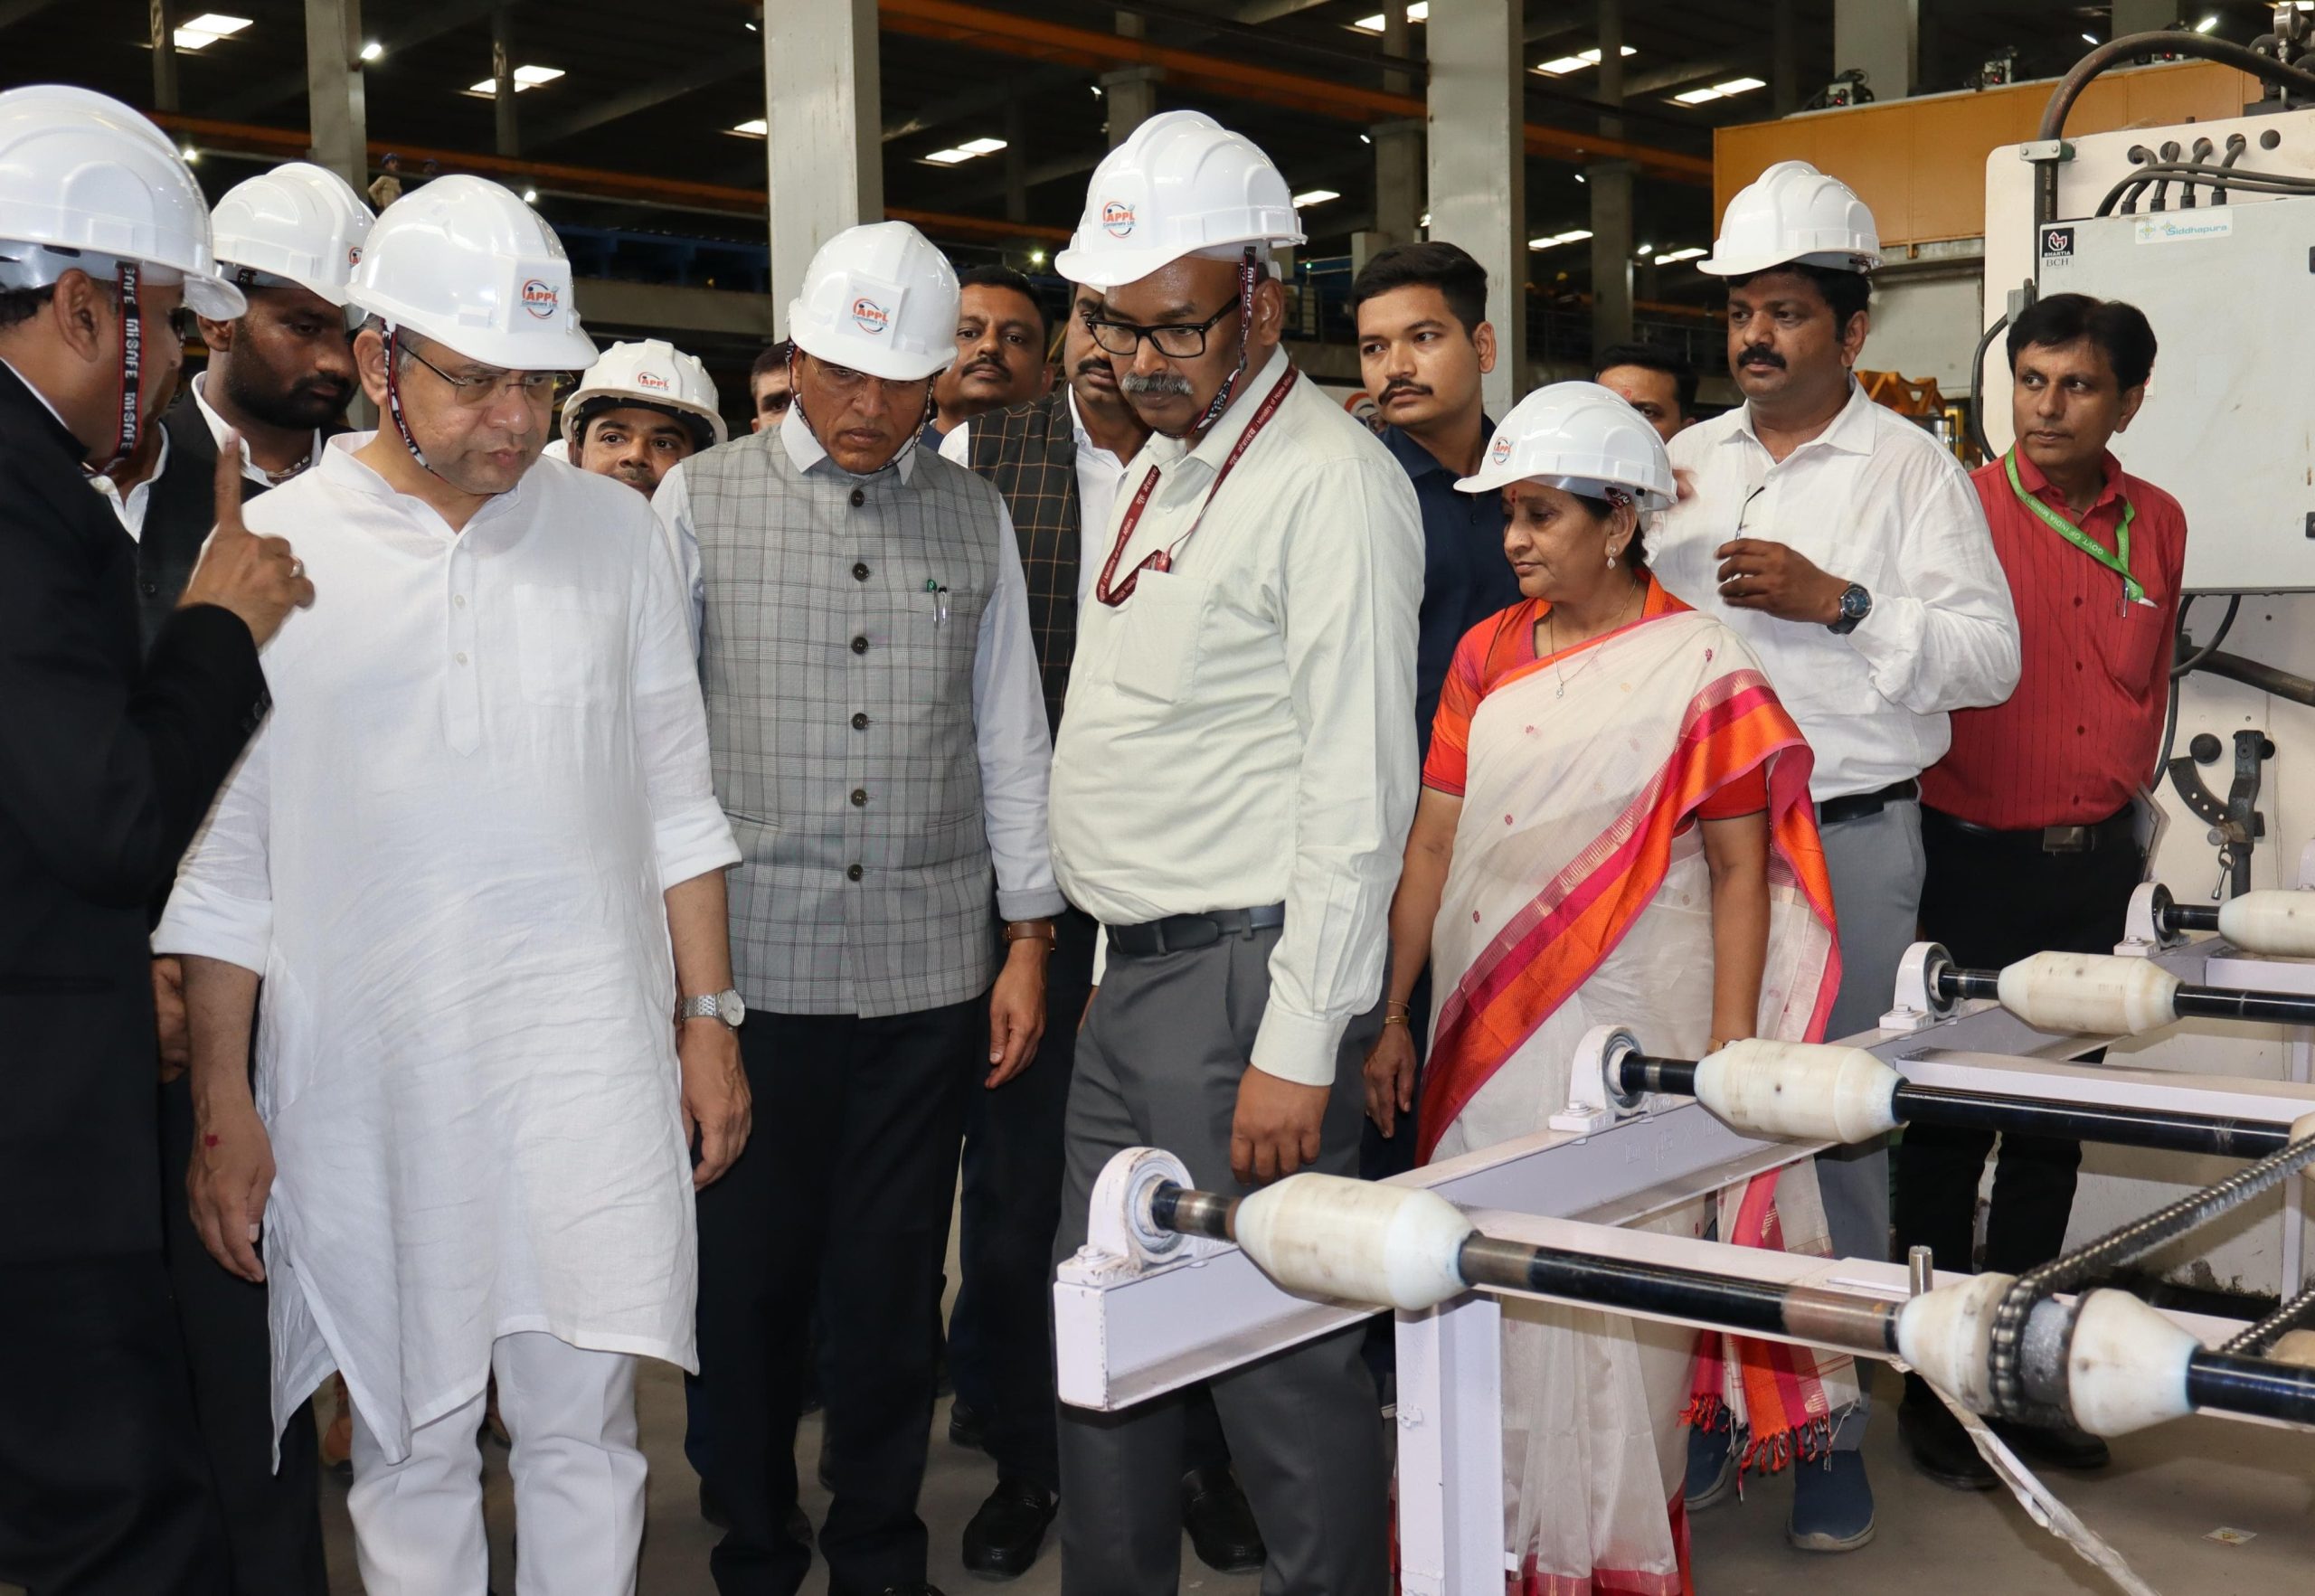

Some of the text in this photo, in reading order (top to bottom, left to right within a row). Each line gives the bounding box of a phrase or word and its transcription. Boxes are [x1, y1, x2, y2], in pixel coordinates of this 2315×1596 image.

[1106, 212, 1135, 222] APPL
[2166, 223, 2227, 236] Siddhapura
[2046, 258, 2069, 267] BCH
[526, 291, 558, 304] APPL
[857, 308, 888, 322] APPL
[1257, 405, 1273, 424] Ministry
[2050, 515, 2069, 532] INDIA
[2069, 530, 2080, 540] OF
